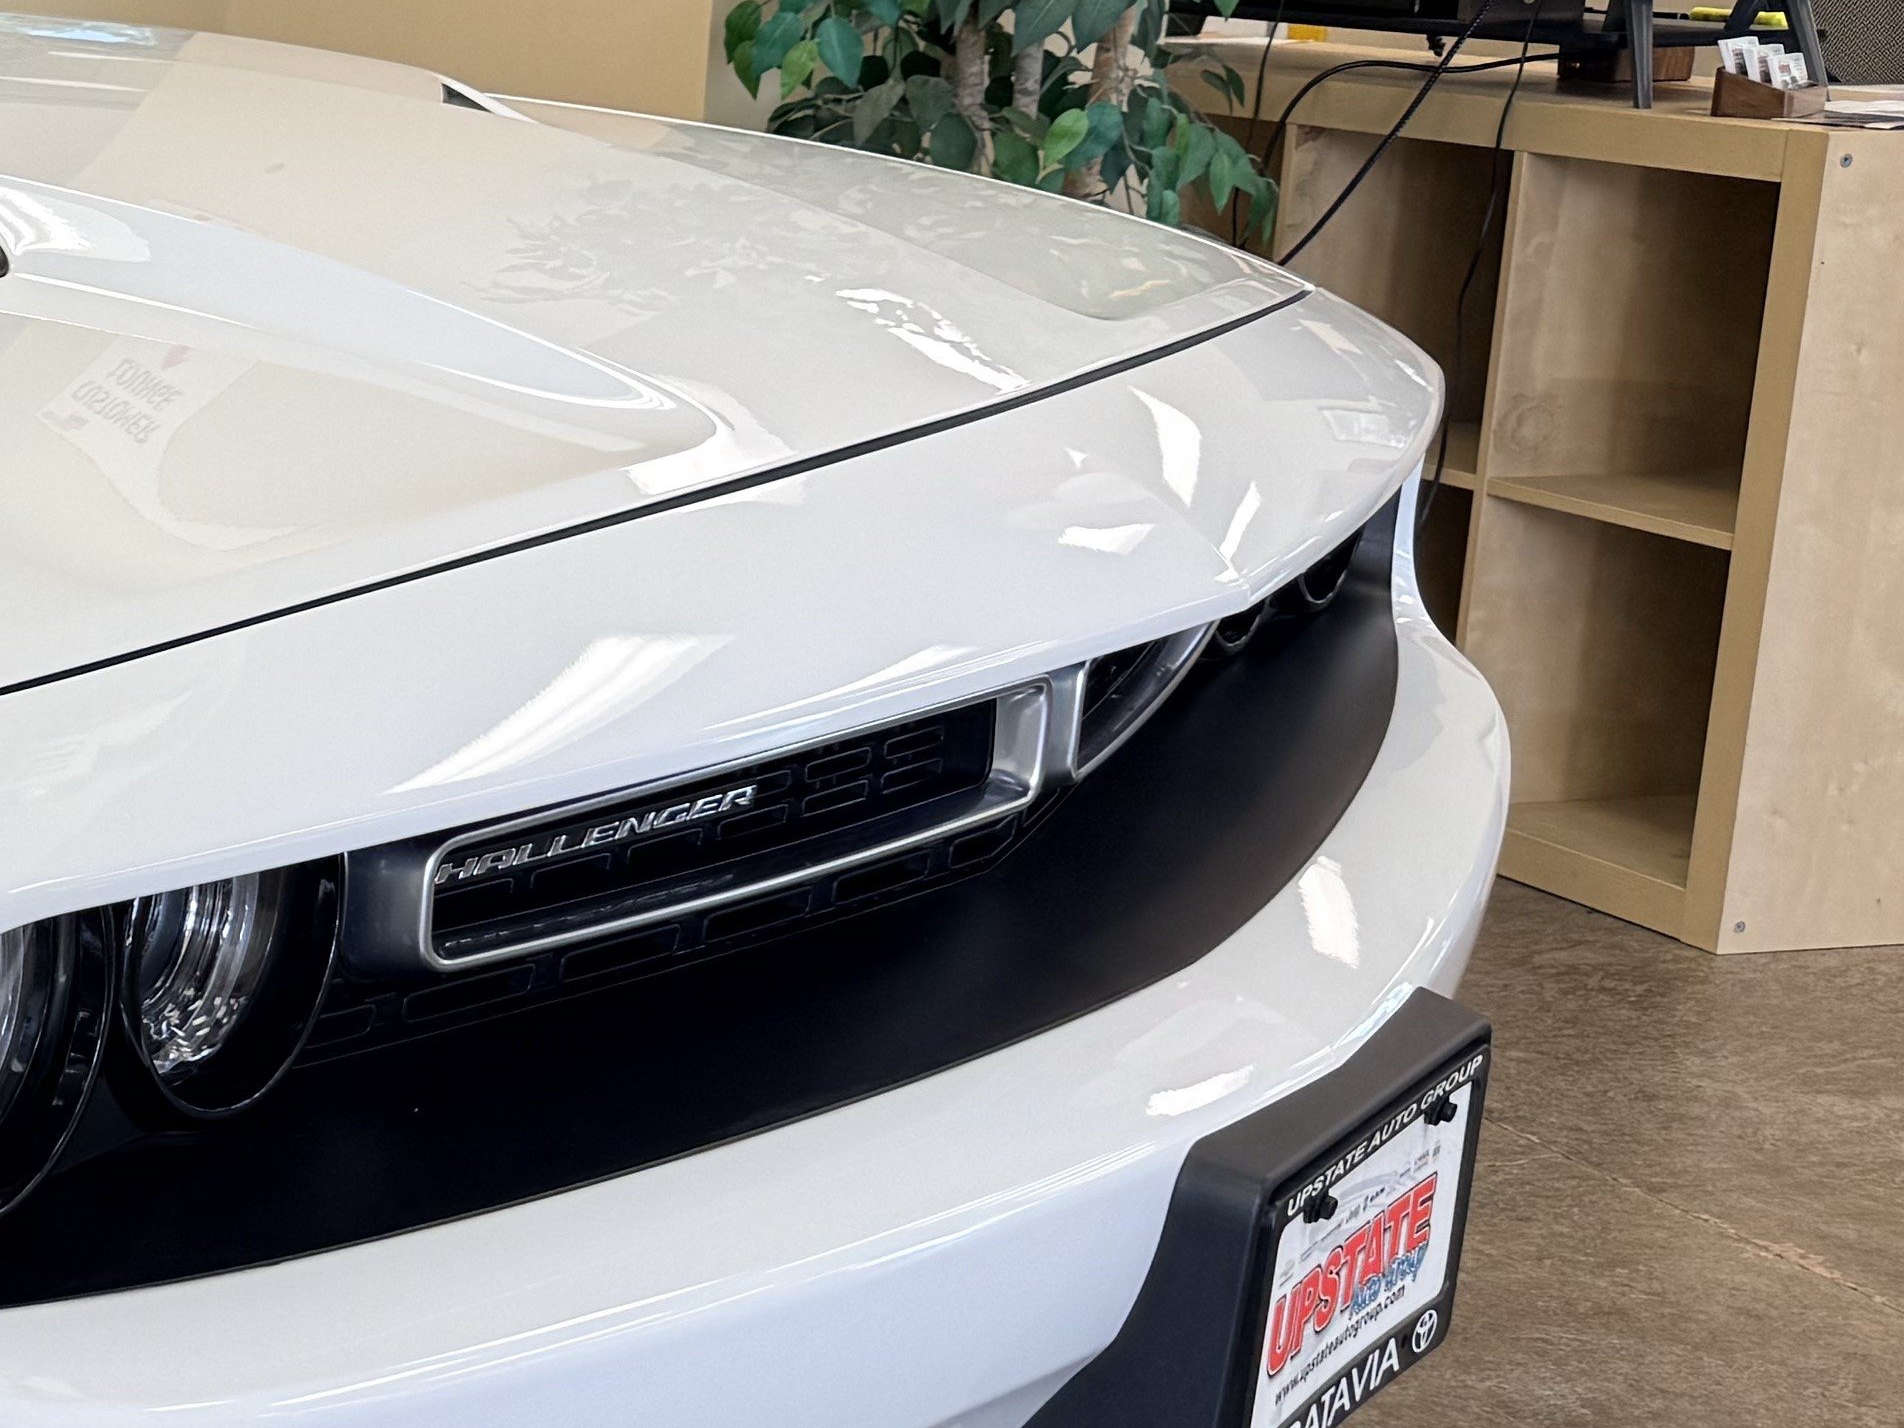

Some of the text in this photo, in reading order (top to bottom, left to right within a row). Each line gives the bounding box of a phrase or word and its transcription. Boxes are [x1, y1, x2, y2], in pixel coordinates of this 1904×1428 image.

[434, 785, 758, 885] HALLENGER
[1286, 1140, 1368, 1217] UPSTATE
[1368, 1102, 1417, 1160] AUTO
[1420, 1054, 1484, 1113] GROUP
[1266, 1170, 1438, 1379] UPSTATE
[1275, 1284, 1406, 1406] www.upstateautogroup.com
